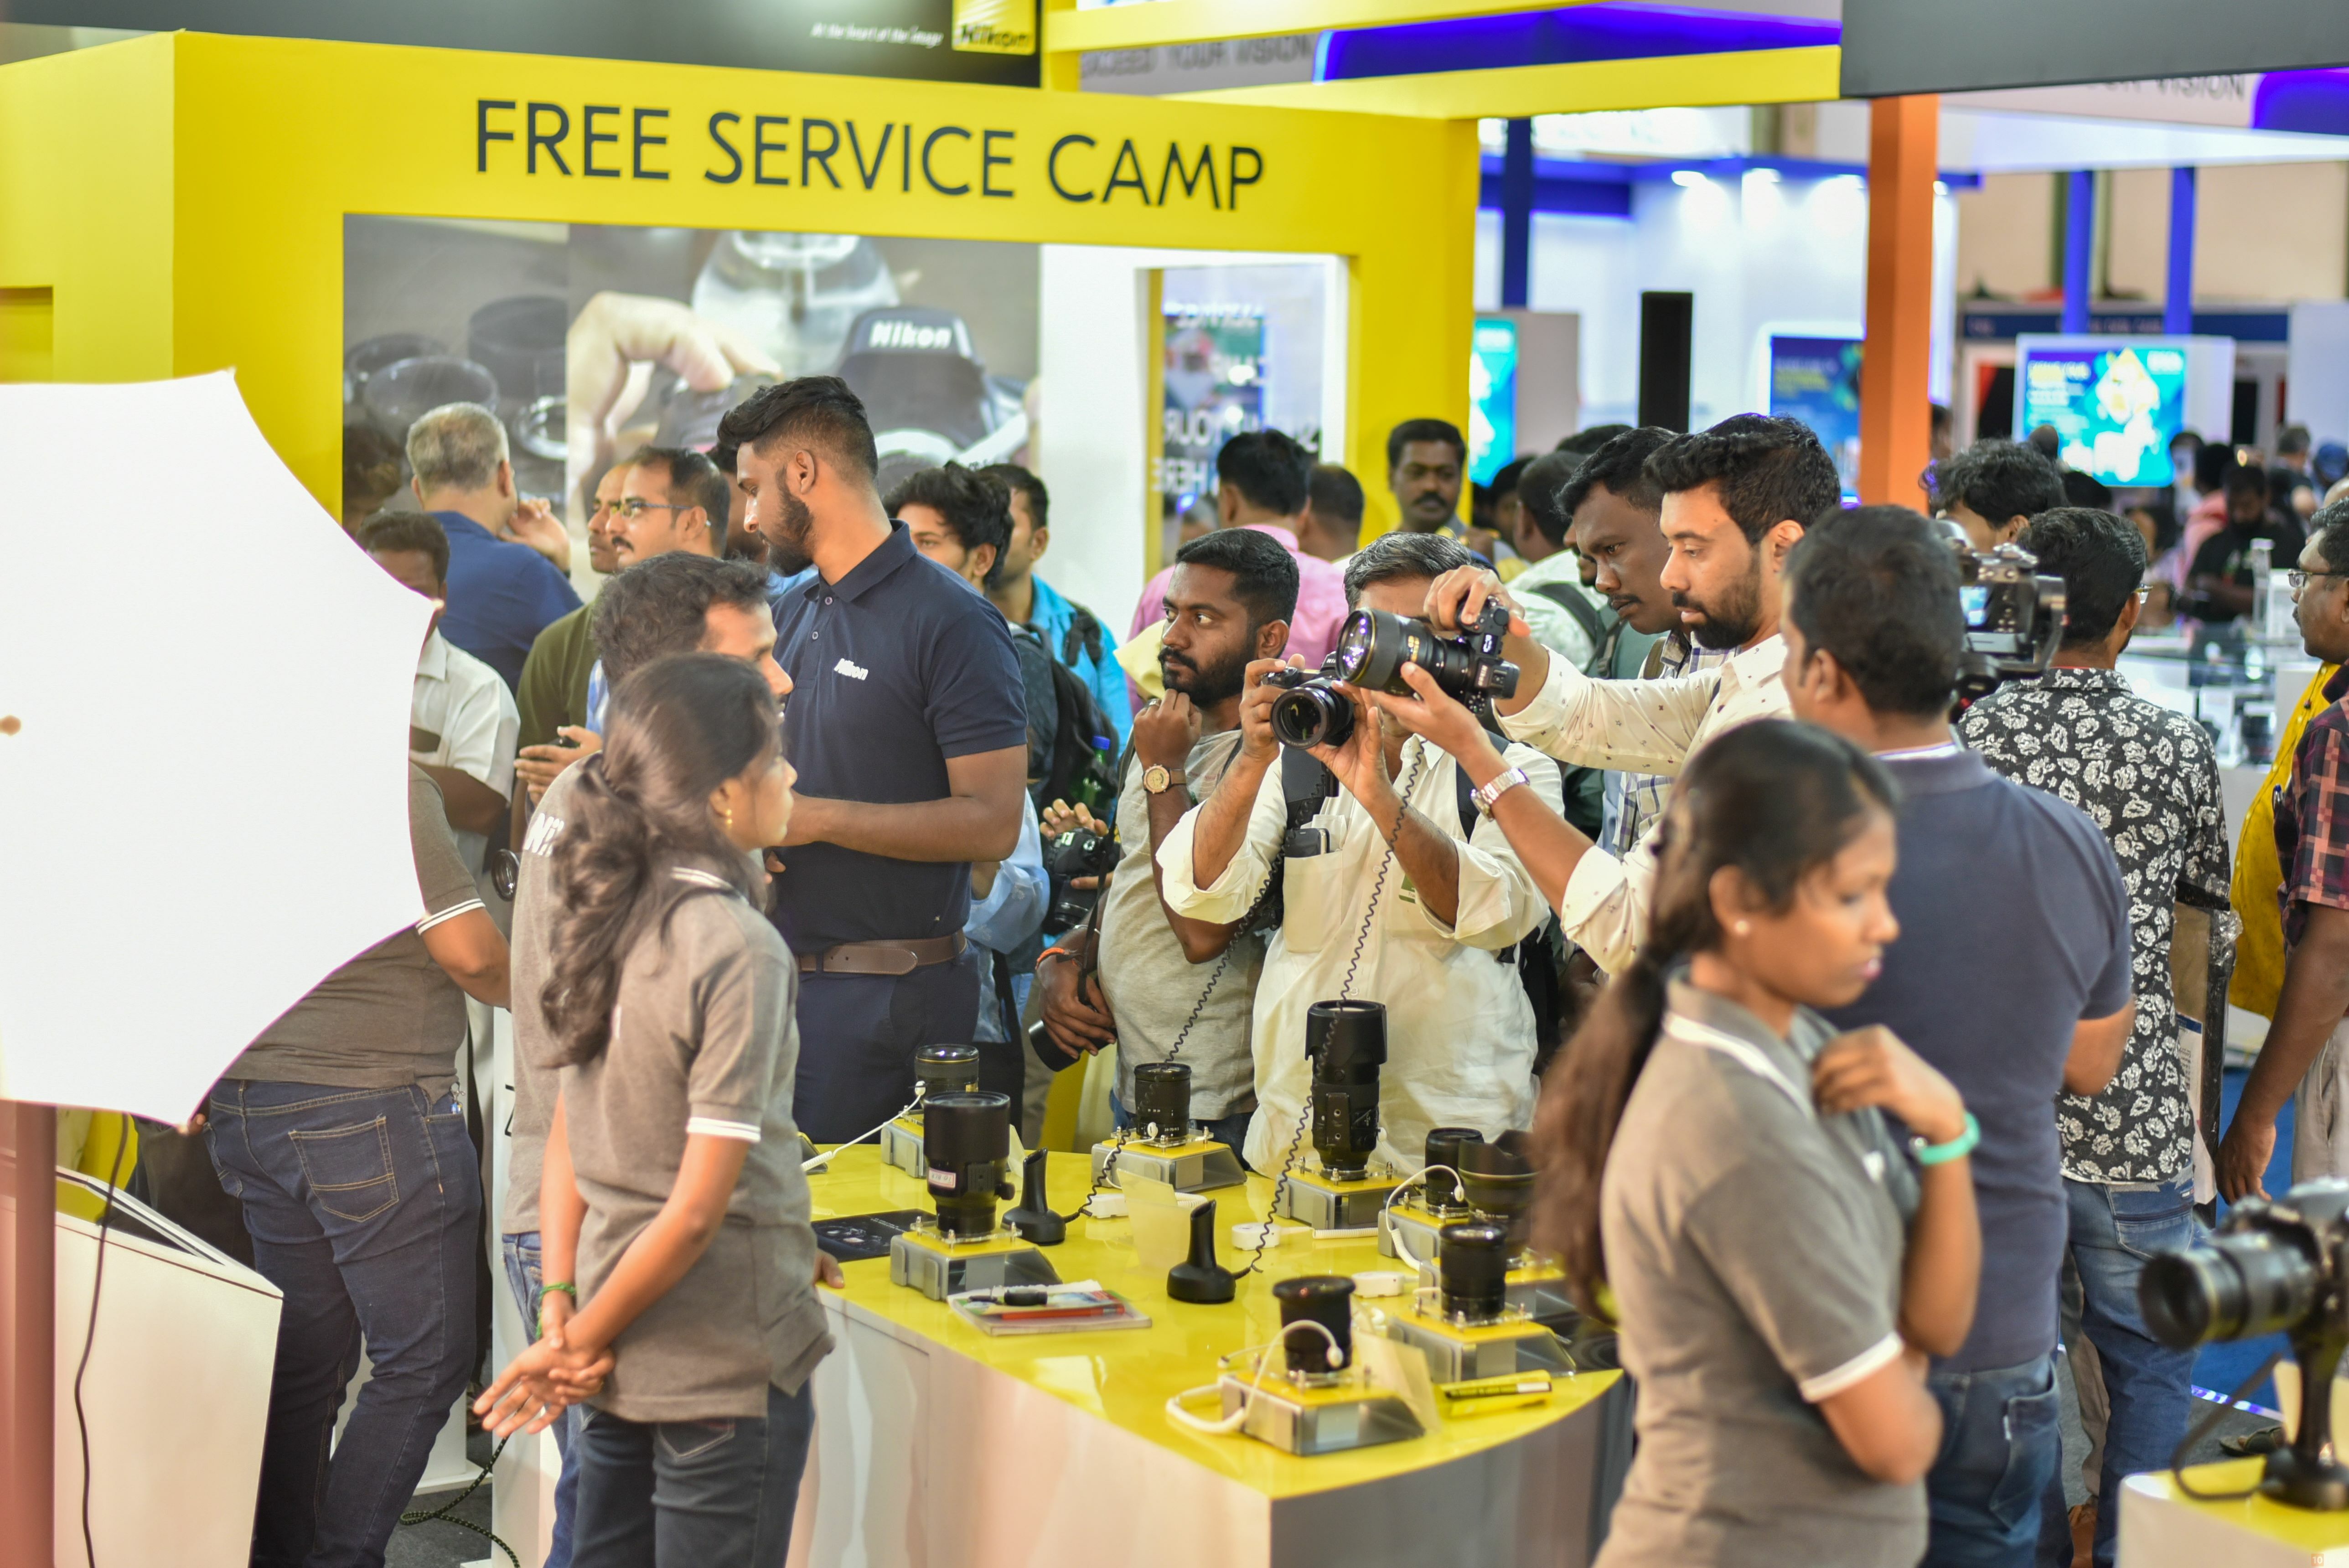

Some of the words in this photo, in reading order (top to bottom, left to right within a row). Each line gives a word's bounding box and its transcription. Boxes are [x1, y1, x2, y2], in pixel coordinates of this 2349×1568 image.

[826, 23, 844, 40] the
[889, 28, 908, 44] the
[477, 99, 670, 181] FREE
[704, 111, 1015, 198] SERVICE
[1047, 134, 1264, 211] CAMP
[869, 320, 952, 349] Nikon
[833, 658, 869, 681] Nikon
